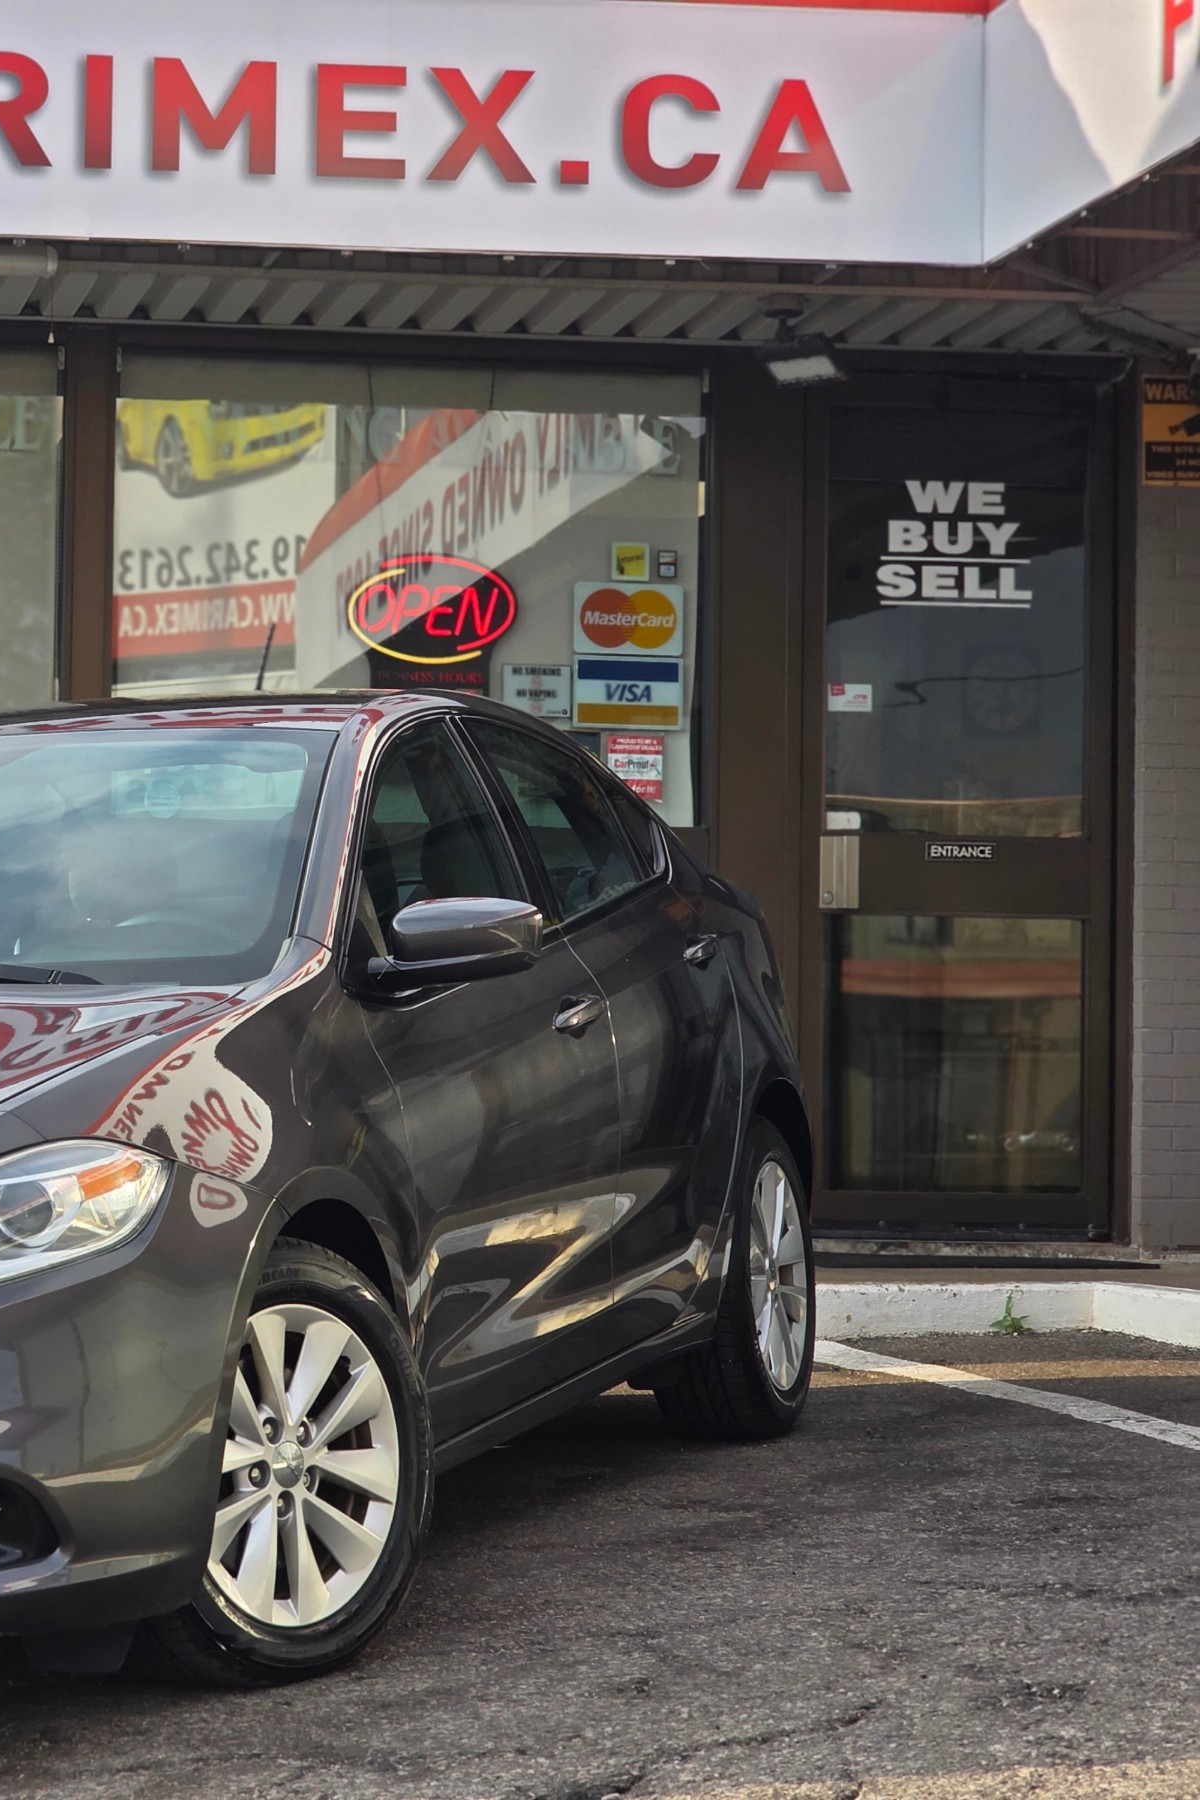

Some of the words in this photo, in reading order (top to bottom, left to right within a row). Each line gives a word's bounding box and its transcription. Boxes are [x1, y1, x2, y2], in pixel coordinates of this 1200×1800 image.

[905, 480, 1006, 515] WE
[888, 520, 1020, 555] BUY
[876, 565, 1033, 600] SELL
[357, 583, 499, 637] OPEN
[584, 610, 674, 628] MasterCard
[438, 672, 486, 683] HOURS
[512, 667, 523, 676] NO
[525, 667, 561, 677] SMOKING
[516, 689, 527, 698] NO
[528, 689, 557, 698] VAPING
[604, 683, 652, 702] VISA
[614, 759, 649, 769] CarProof
[930, 845, 992, 858] ENTRANCE
